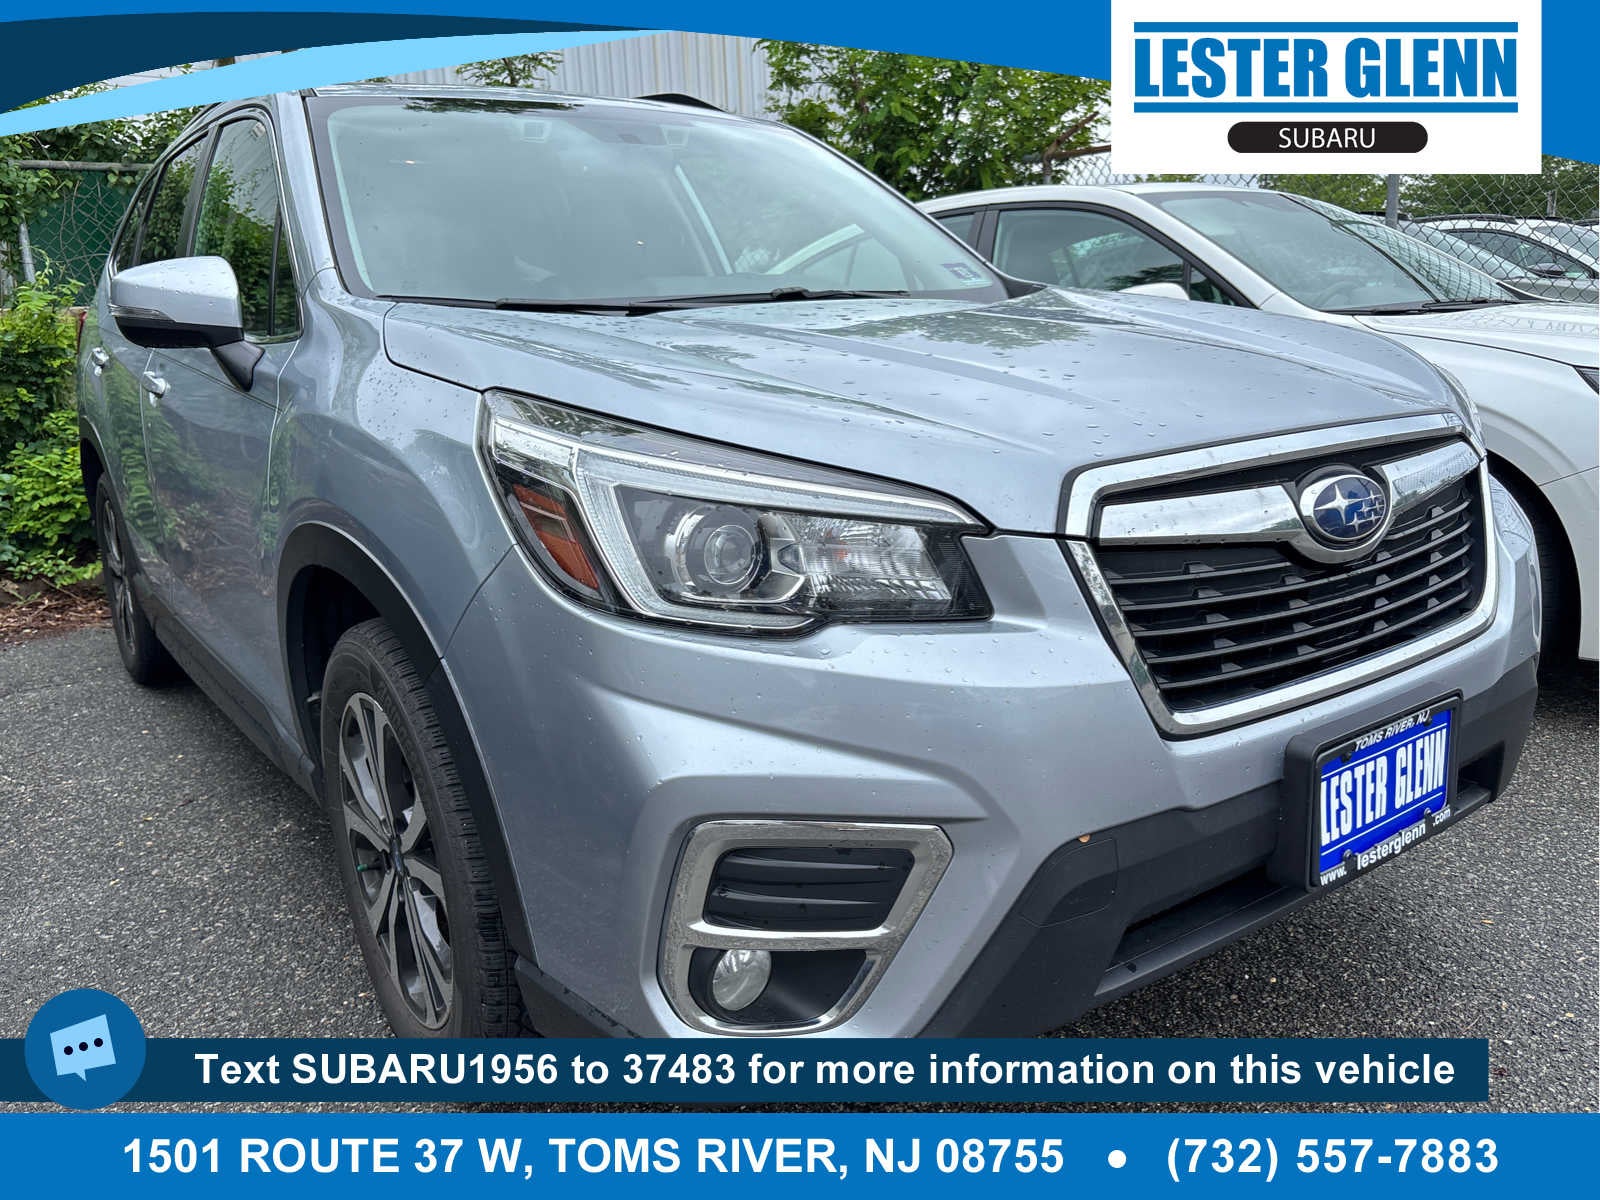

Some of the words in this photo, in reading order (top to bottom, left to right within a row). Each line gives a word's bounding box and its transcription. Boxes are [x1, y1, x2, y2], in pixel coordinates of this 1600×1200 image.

[1354, 730, 1384, 752] TOMS
[1385, 717, 1415, 738] RIVER,
[1416, 709, 1431, 724] NJ
[1320, 755, 1388, 847] LESTER
[1395, 728, 1447, 810] GLENN
[1356, 823, 1426, 870] lesterglenn
